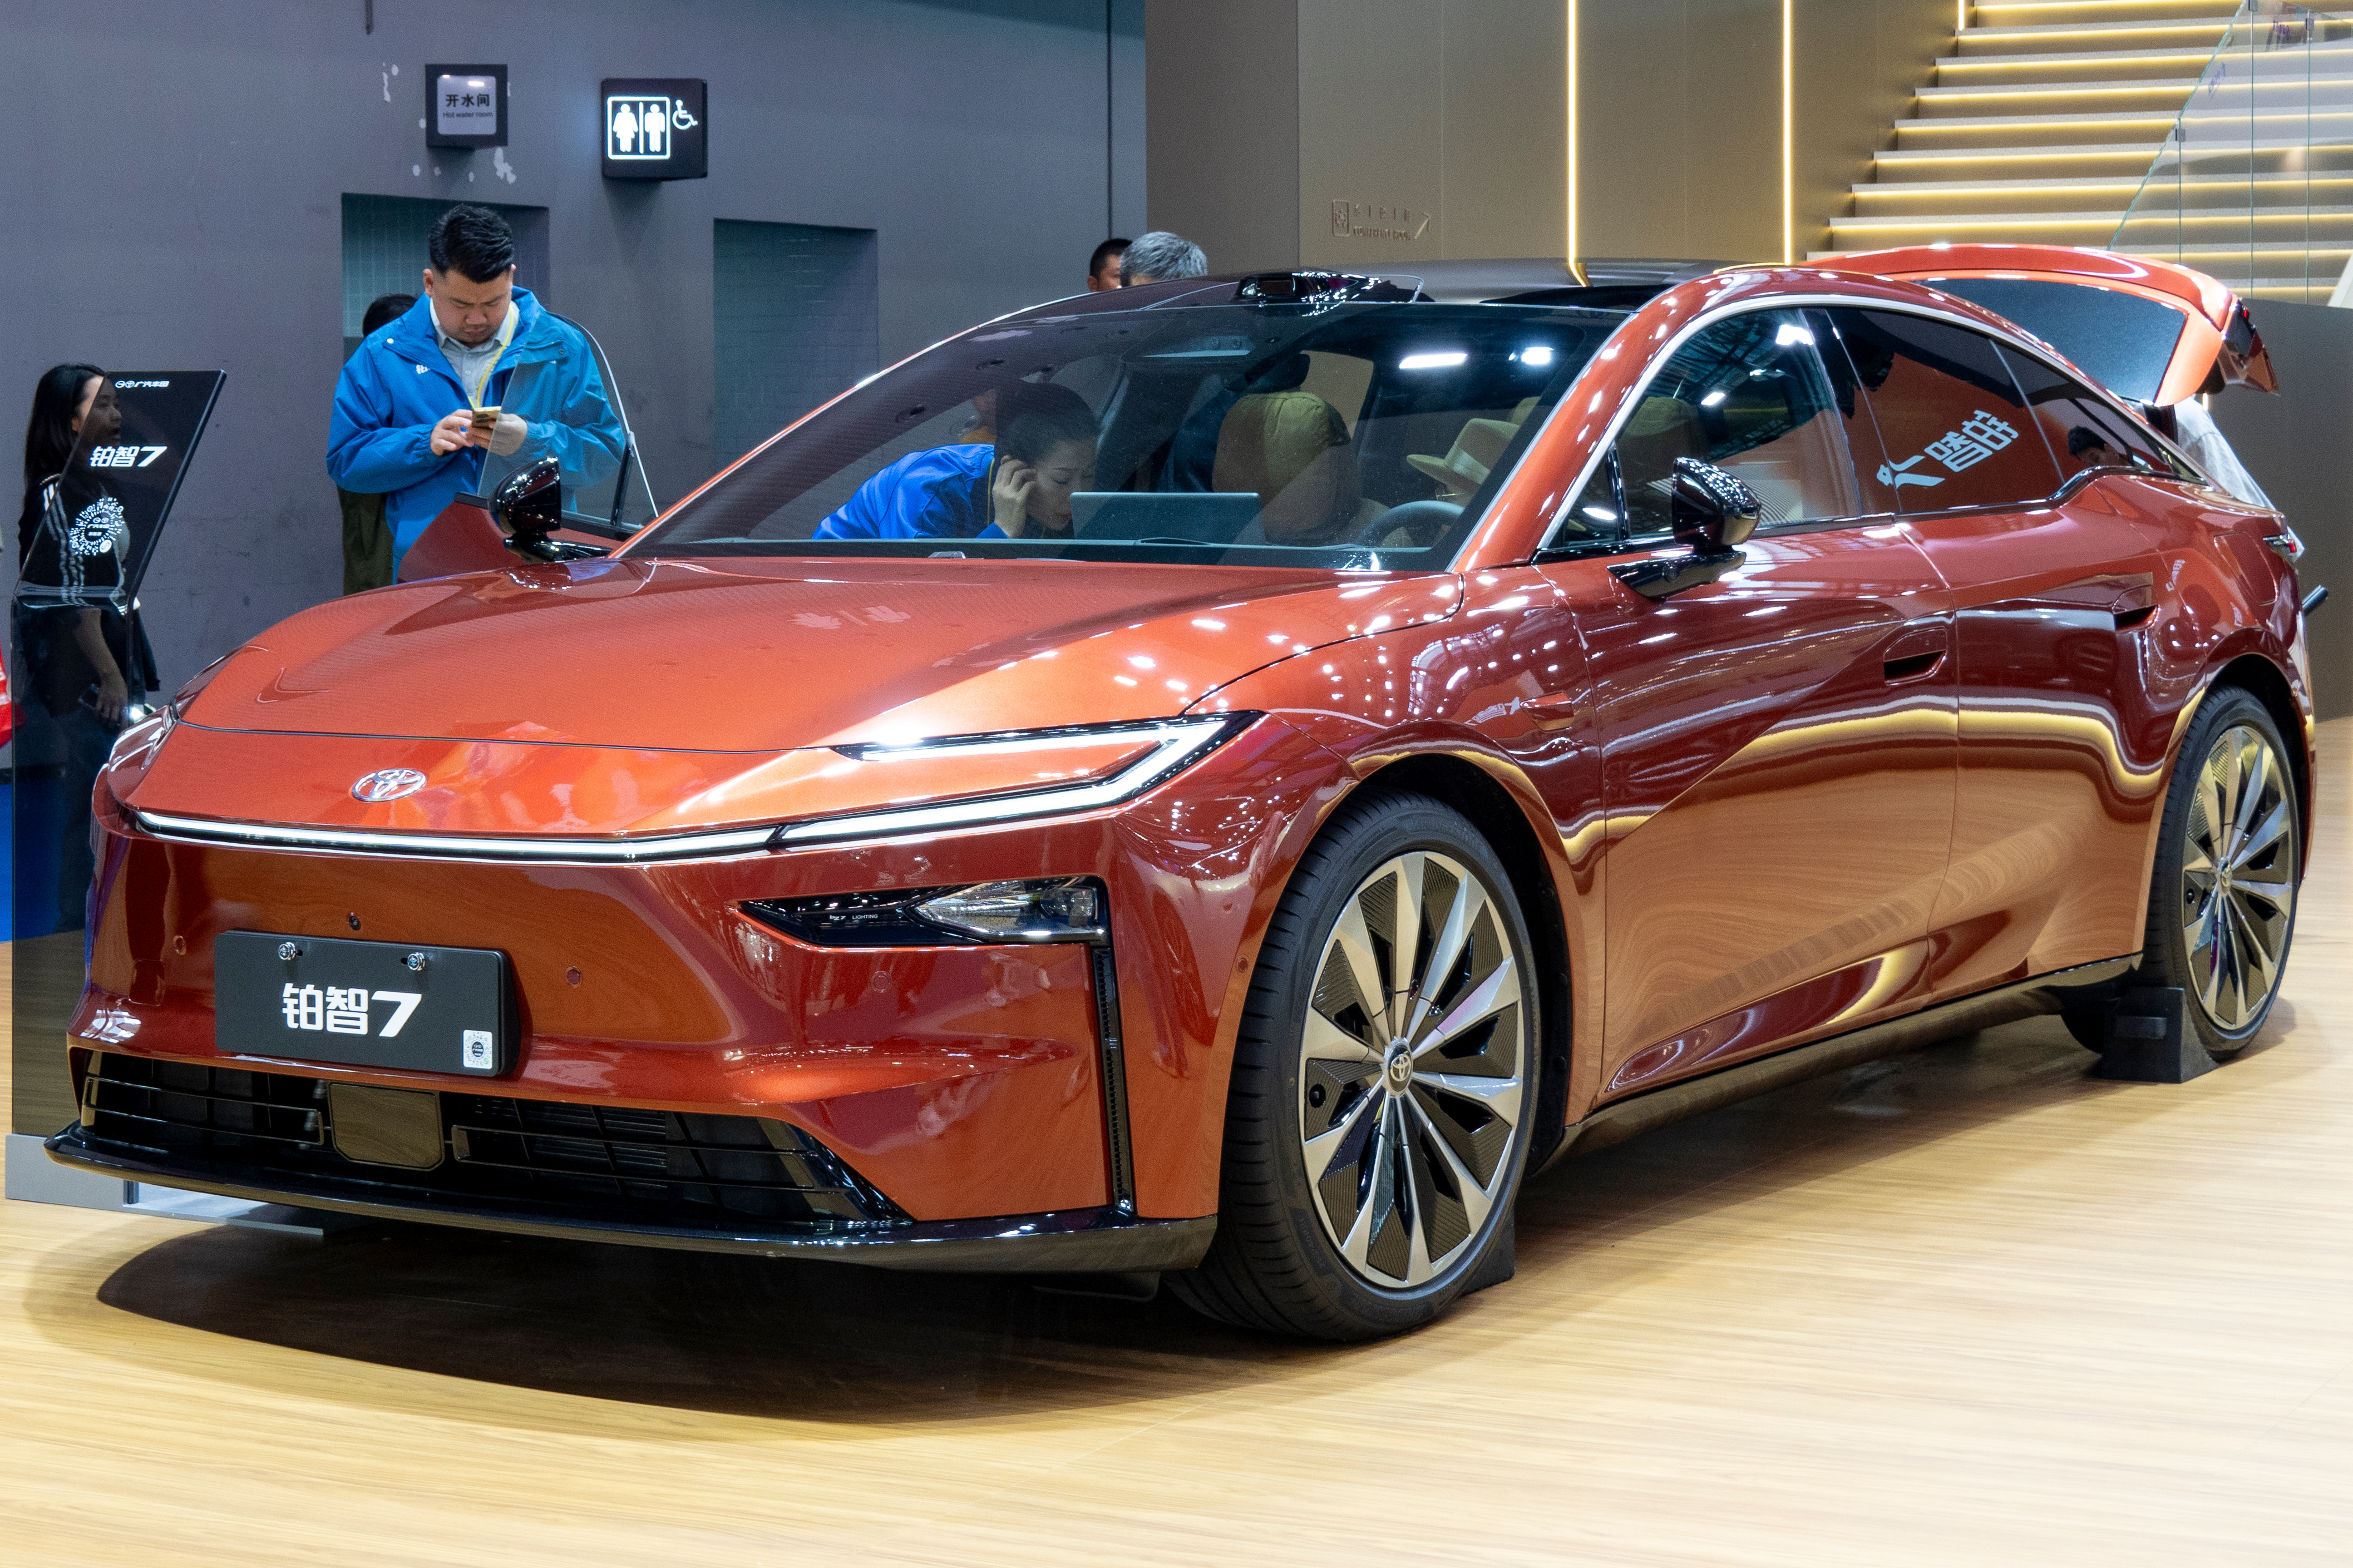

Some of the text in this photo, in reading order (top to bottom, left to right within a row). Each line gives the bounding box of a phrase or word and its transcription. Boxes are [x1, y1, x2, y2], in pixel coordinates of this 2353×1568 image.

[446, 93, 489, 107] 开水间
[90, 446, 167, 467] 铂智7
[282, 983, 422, 1037] 铂智7
